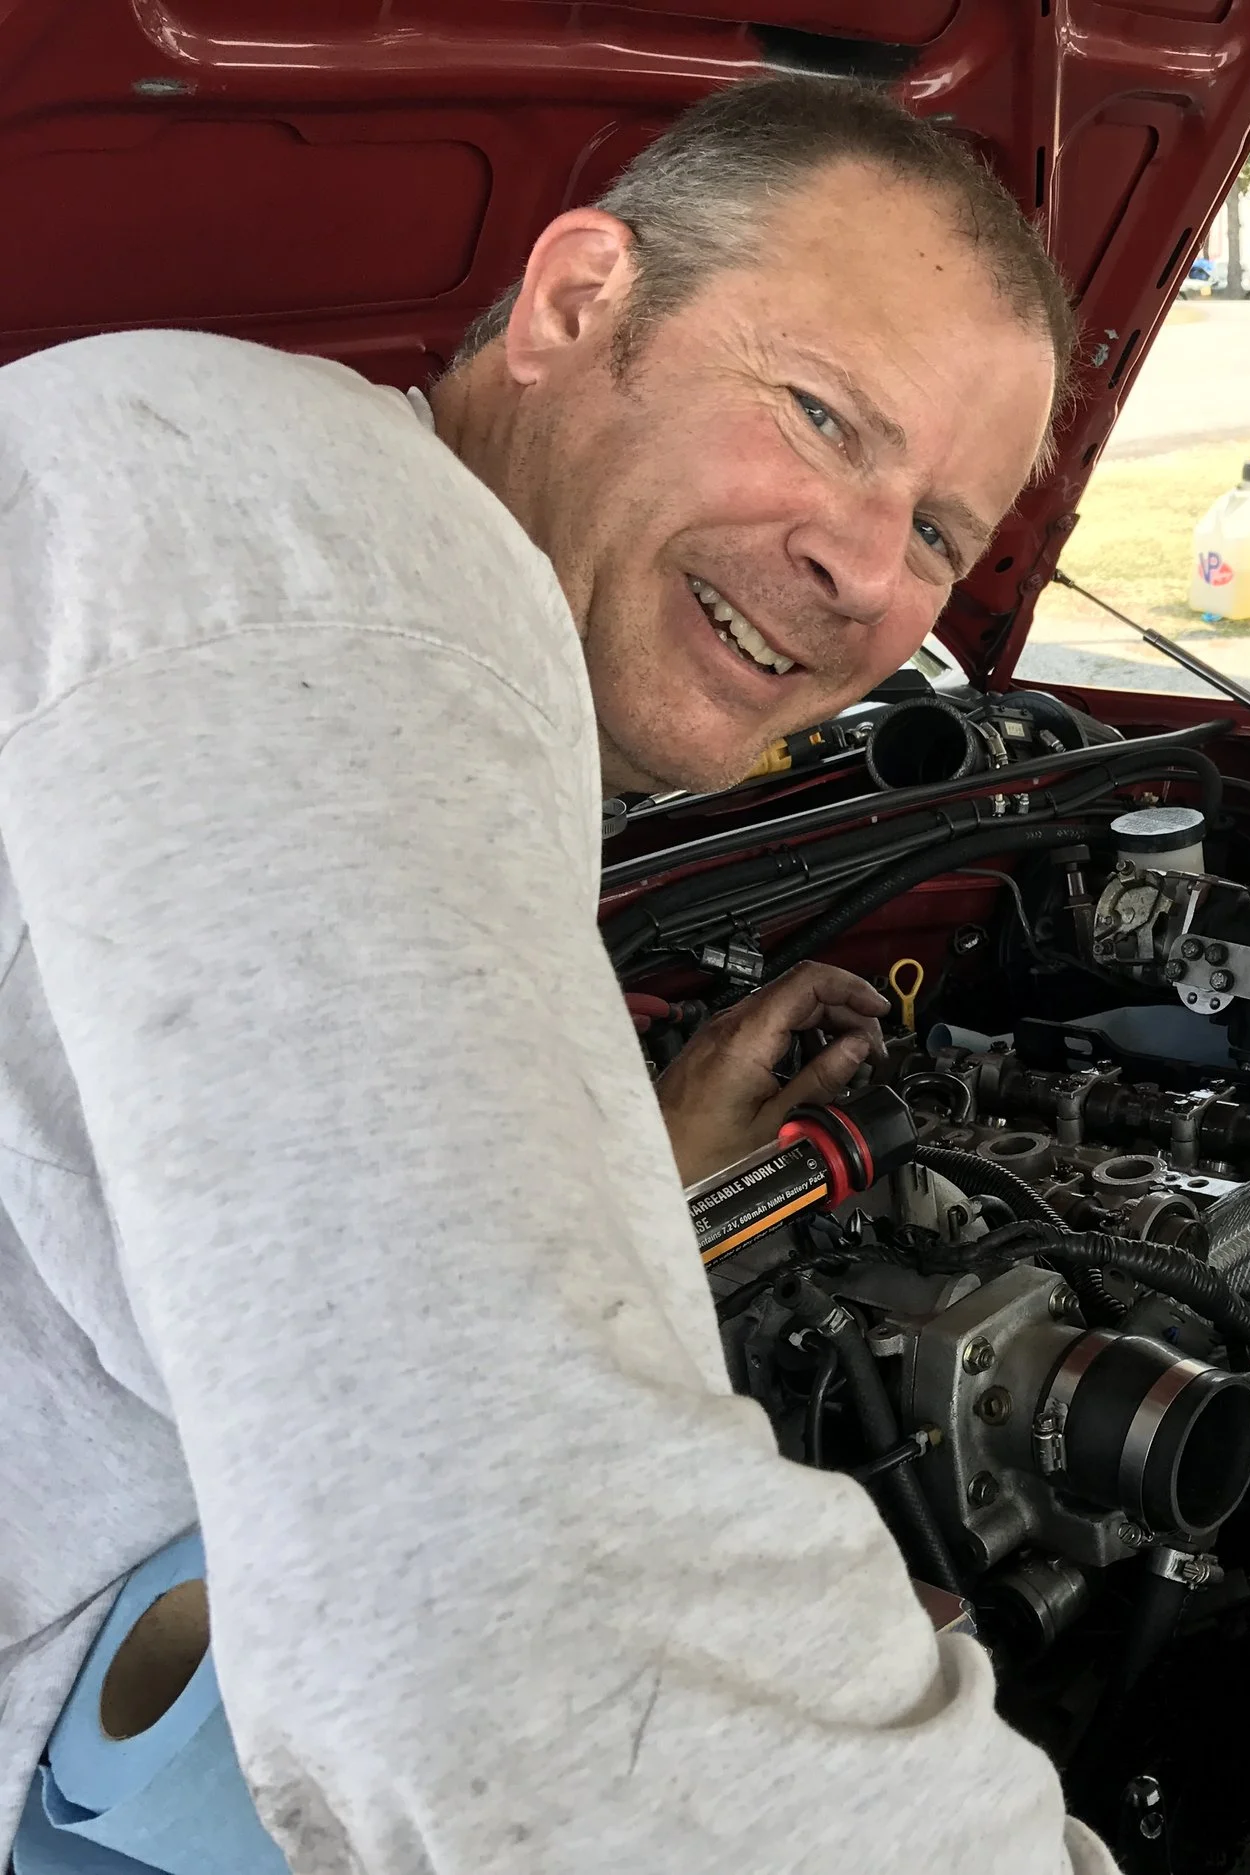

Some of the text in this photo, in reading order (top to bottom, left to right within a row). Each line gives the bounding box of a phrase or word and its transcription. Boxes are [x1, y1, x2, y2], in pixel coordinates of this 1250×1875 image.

[1199, 551, 1221, 584] VP
[740, 1163, 777, 1187] WORK
[773, 1147, 804, 1170] LIGHT
[721, 1219, 741, 1235] 7.2V,
[739, 1202, 768, 1225] 600mAh
[767, 1192, 786, 1208] NiMH
[785, 1181, 809, 1199] Battery
